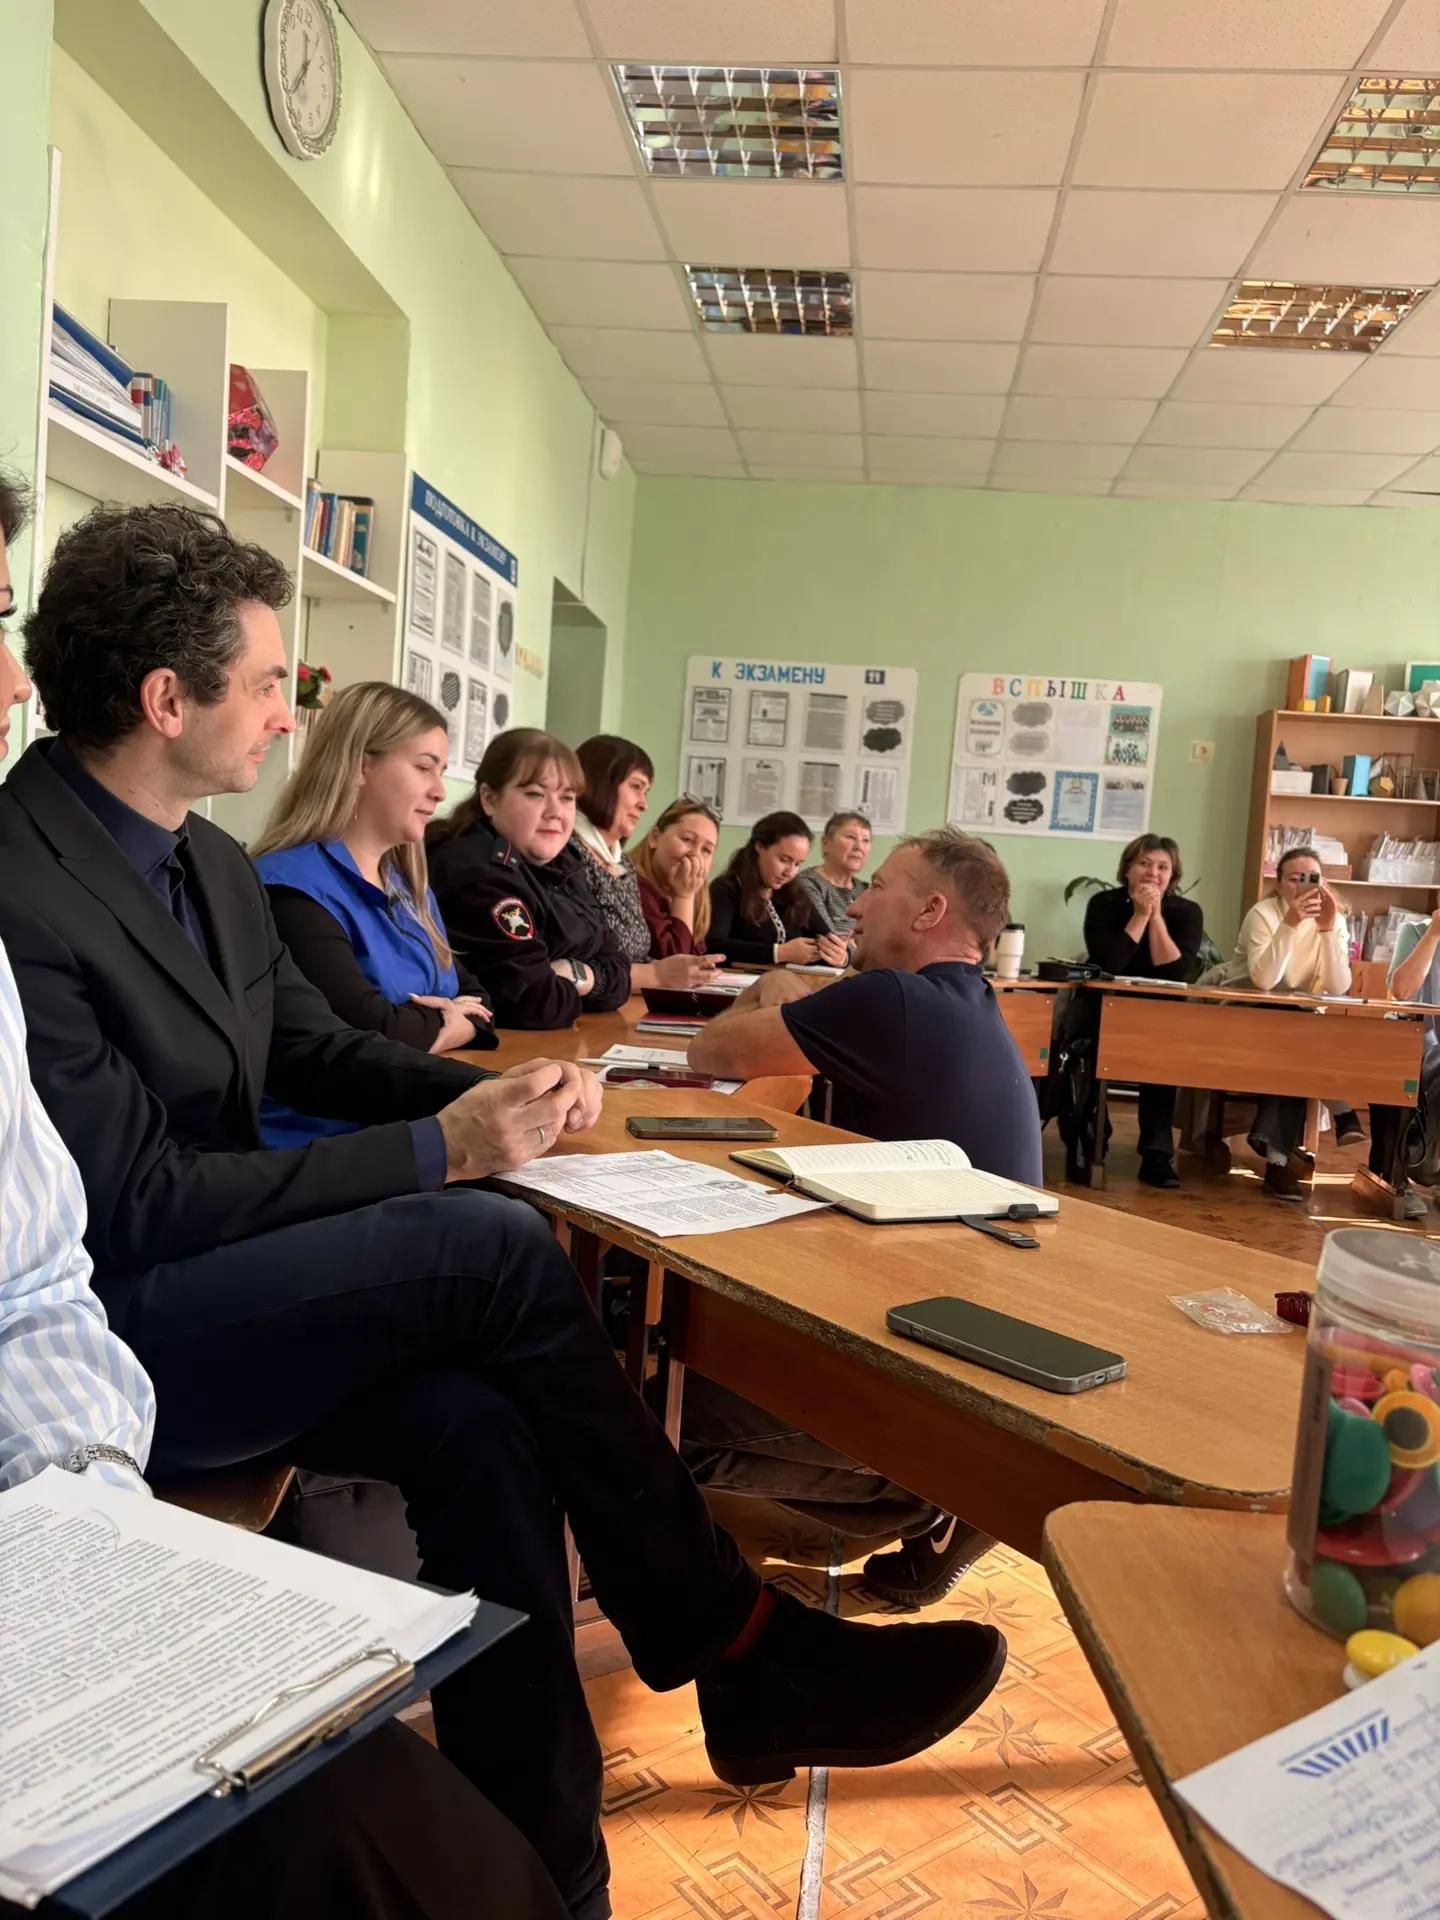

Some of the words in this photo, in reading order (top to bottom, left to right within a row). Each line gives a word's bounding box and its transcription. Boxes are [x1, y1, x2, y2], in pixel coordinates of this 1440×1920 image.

[711, 661, 723, 679] К
[735, 662, 826, 685] ЭКЗАМЕНУ
[991, 677, 1126, 701] ВСПЫШКА
